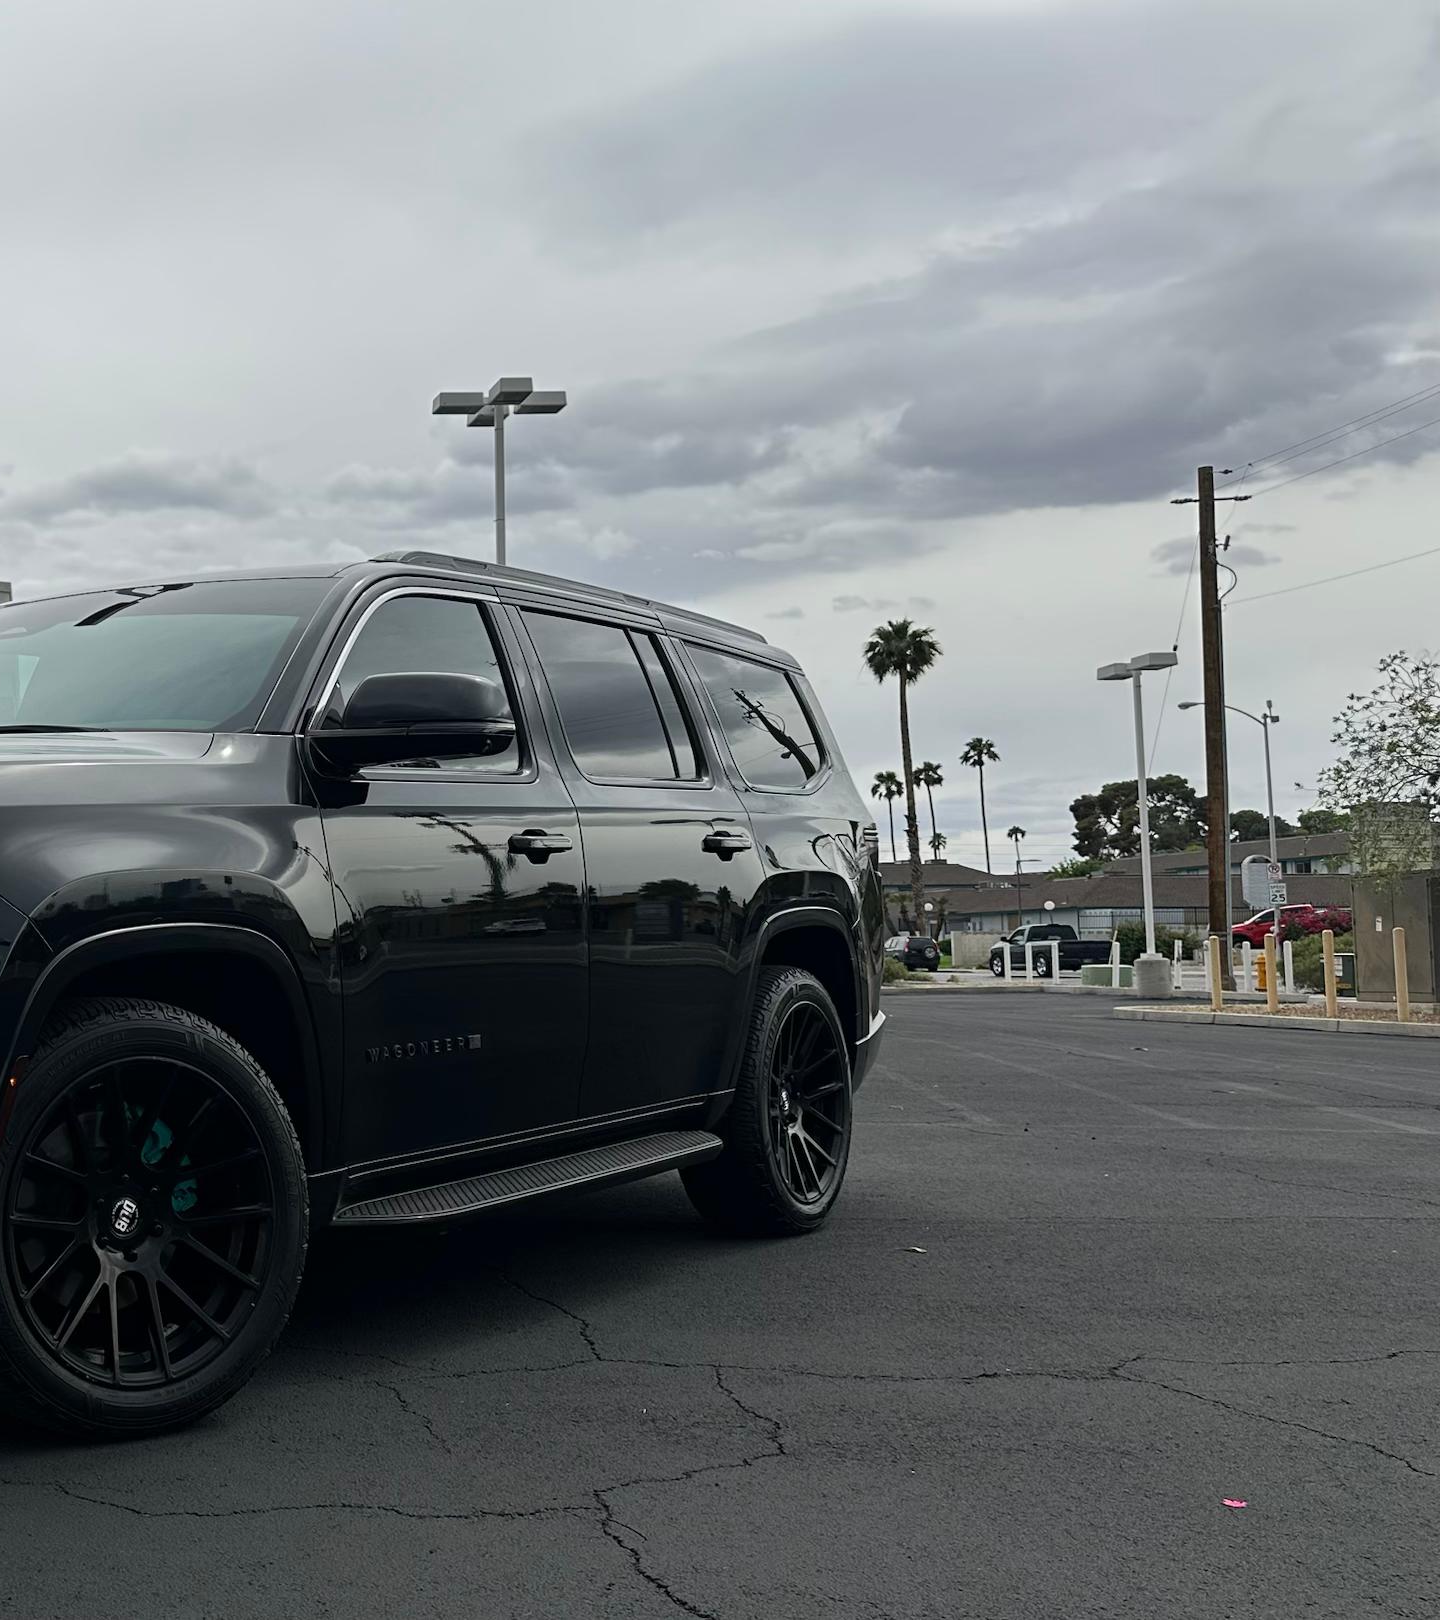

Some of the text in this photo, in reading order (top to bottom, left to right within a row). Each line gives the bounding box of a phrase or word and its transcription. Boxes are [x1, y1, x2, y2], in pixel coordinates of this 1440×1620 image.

[1271, 894, 1285, 902] 25
[366, 1038, 465, 1064] WAGONEER
[114, 1199, 137, 1233] DUB
